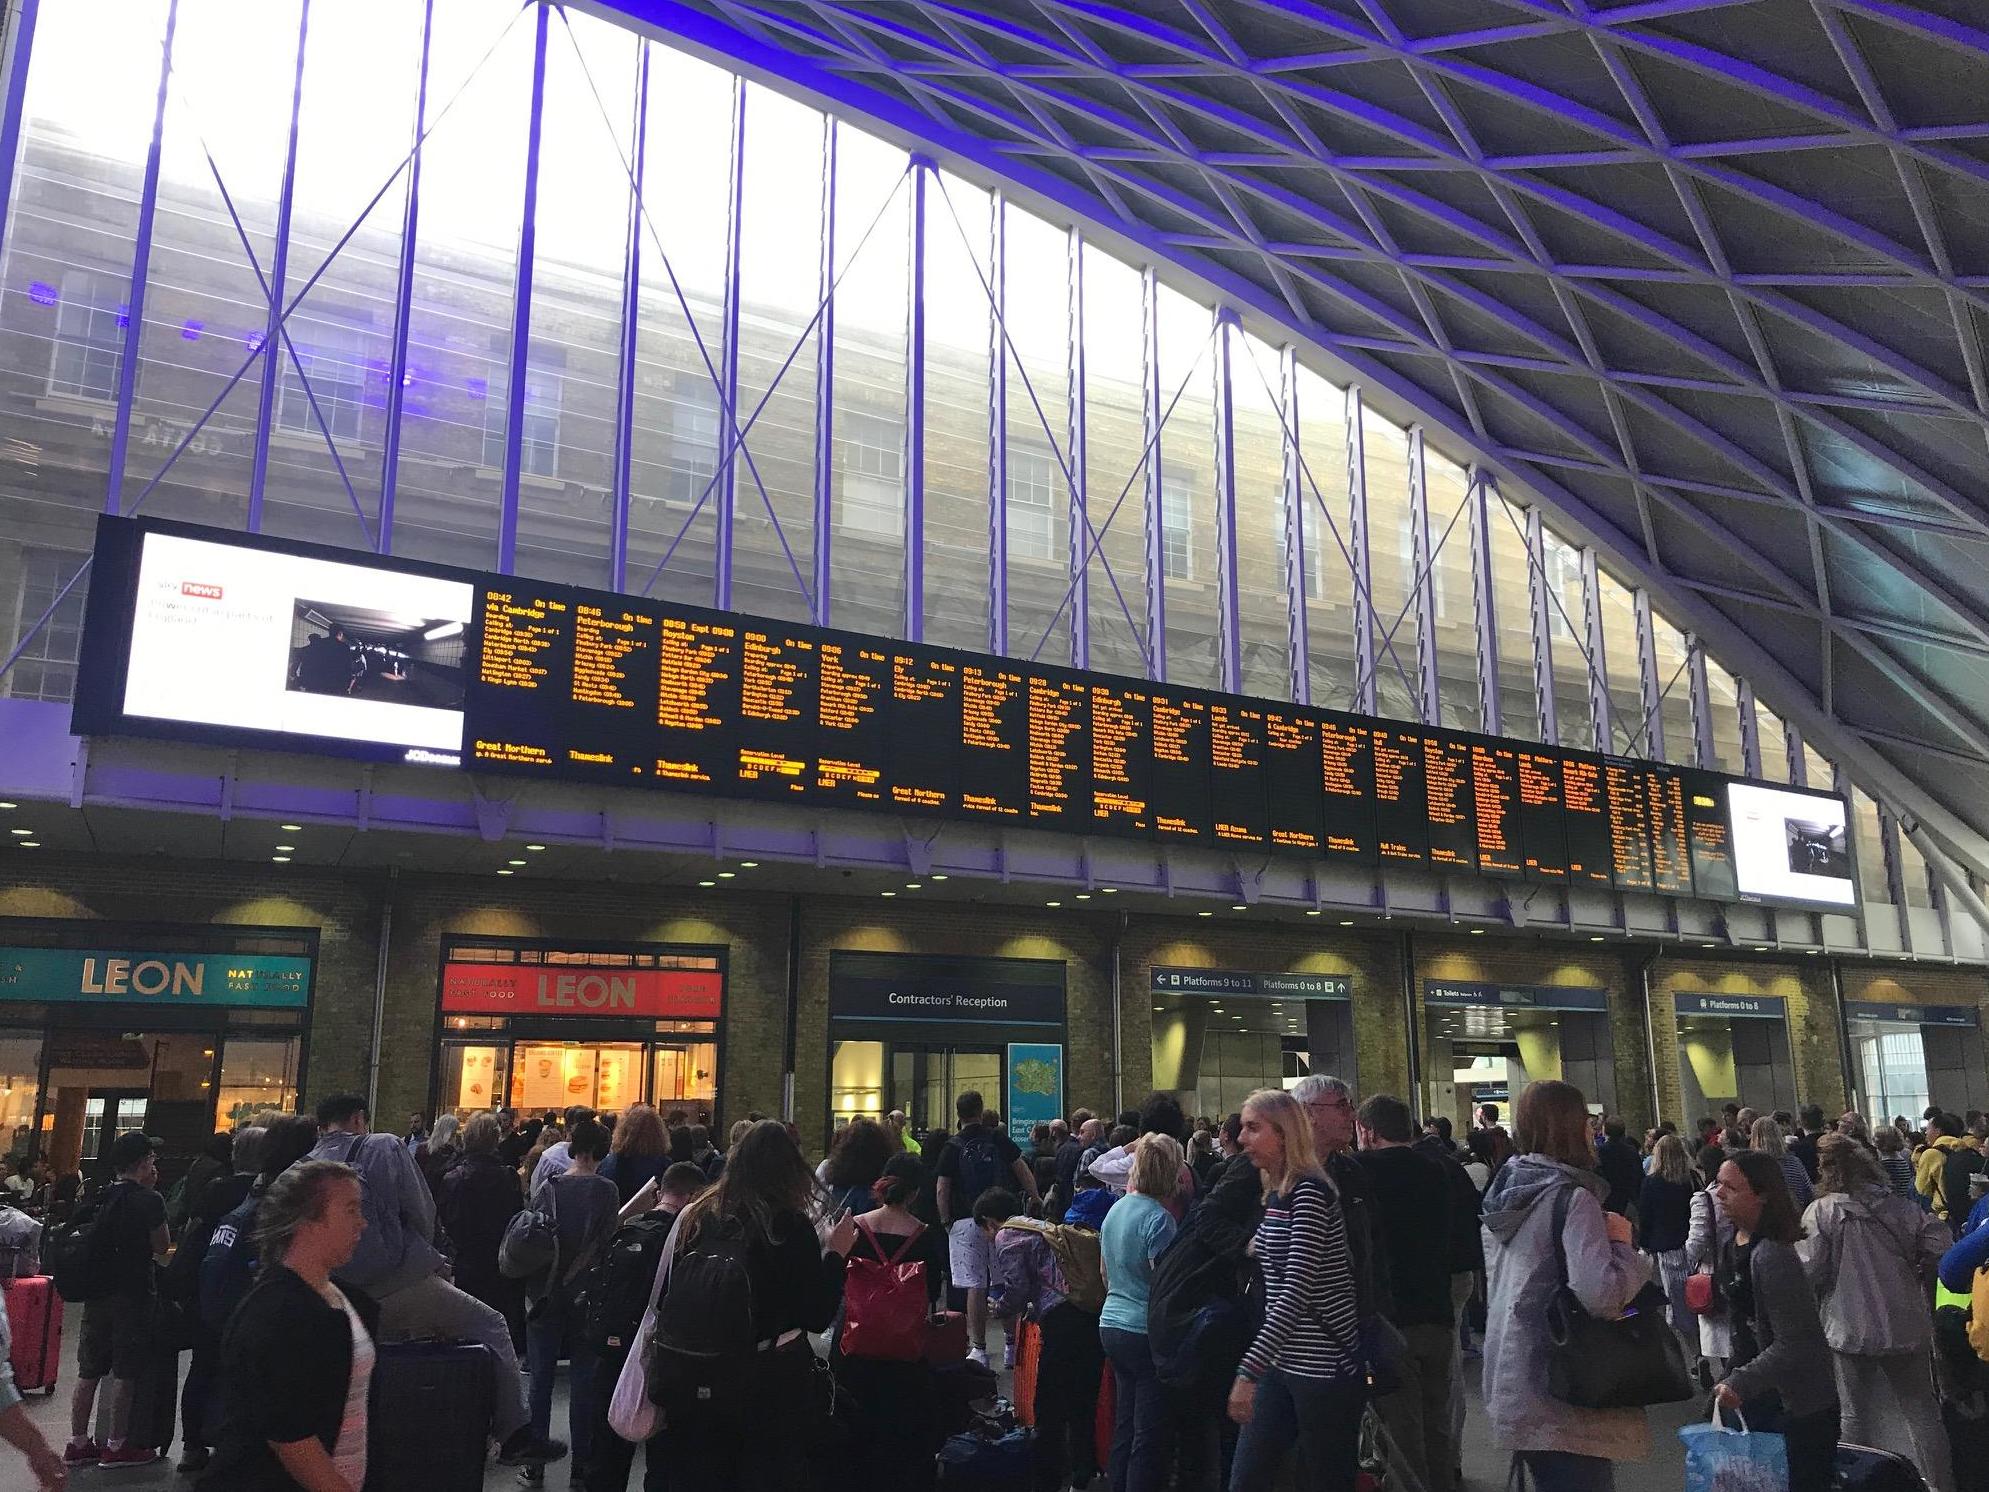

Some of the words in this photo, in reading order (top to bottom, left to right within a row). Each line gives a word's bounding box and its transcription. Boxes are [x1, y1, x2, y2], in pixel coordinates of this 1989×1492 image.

[183, 583, 221, 598] news
[487, 592, 512, 602] 08:42
[535, 600, 545, 608] On
[549, 601, 566, 611] time
[487, 603, 499, 611] via
[503, 605, 545, 618] Cambridge
[578, 606, 601, 616] 08:46
[623, 613, 633, 621] On
[637, 615, 652, 624] time
[578, 616, 633, 632] Peterborough
[692, 624, 709, 633] Expt
[663, 629, 694, 641] Royston
[745, 632, 766, 642] 09:00
[786, 639, 795, 647] On
[798, 641, 812, 650] time
[745, 642, 781, 654] Edinburgh
[822, 644, 841, 654] 09:06
[871, 653, 885, 661] time
[822, 654, 838, 663] York
[894, 656, 913, 666] 09:12
[930, 662, 939, 670] On
[894, 665, 904, 673] Ely
[963, 667, 982, 676] 09:13
[998, 672, 1006, 680] On
[1009, 674, 1021, 682] time
[963, 676, 1006, 689] Peterborough
[1063, 683, 1070, 691] On
[1030, 687, 1059, 697] Cambridge
[1124, 691, 1132, 699] On
[1134, 693, 1145, 702] time
[1092, 696, 1121, 706] Edinburgh
[1192, 702, 1203, 710] time
[1153, 706, 1180, 715] Cambridge
[1241, 710, 1248, 718] On
[1211, 714, 1228, 722] Leeds
[1274, 724, 1298, 734] Cambridge
[1322, 731, 1356, 741] Peterborough
[476, 740, 502, 752] Great
[505, 744, 546, 756] Northern
[570, 750, 614, 764] Thameslink
[656, 760, 698, 772] Thameslink
[892, 786, 912, 796] Great
[914, 788, 945, 799] Northern
[963, 794, 996, 806] Thameslink
[1030, 802, 1062, 813] Thameslink
[1156, 816, 1186, 826] Thameslink
[1272, 830, 1287, 838] Great
[81, 958, 205, 996] LEON
[1183, 976, 1222, 987] Platforms
[1224, 979, 1228, 987] 9
[1264, 980, 1298, 990] Platforms
[536, 974, 637, 1009] LEON
[889, 993, 953, 1005] Contractors'
[956, 995, 1007, 1009] Reception
[1710, 1000, 1739, 1009] Platforms
[1746, 1002, 1753, 1010] to
